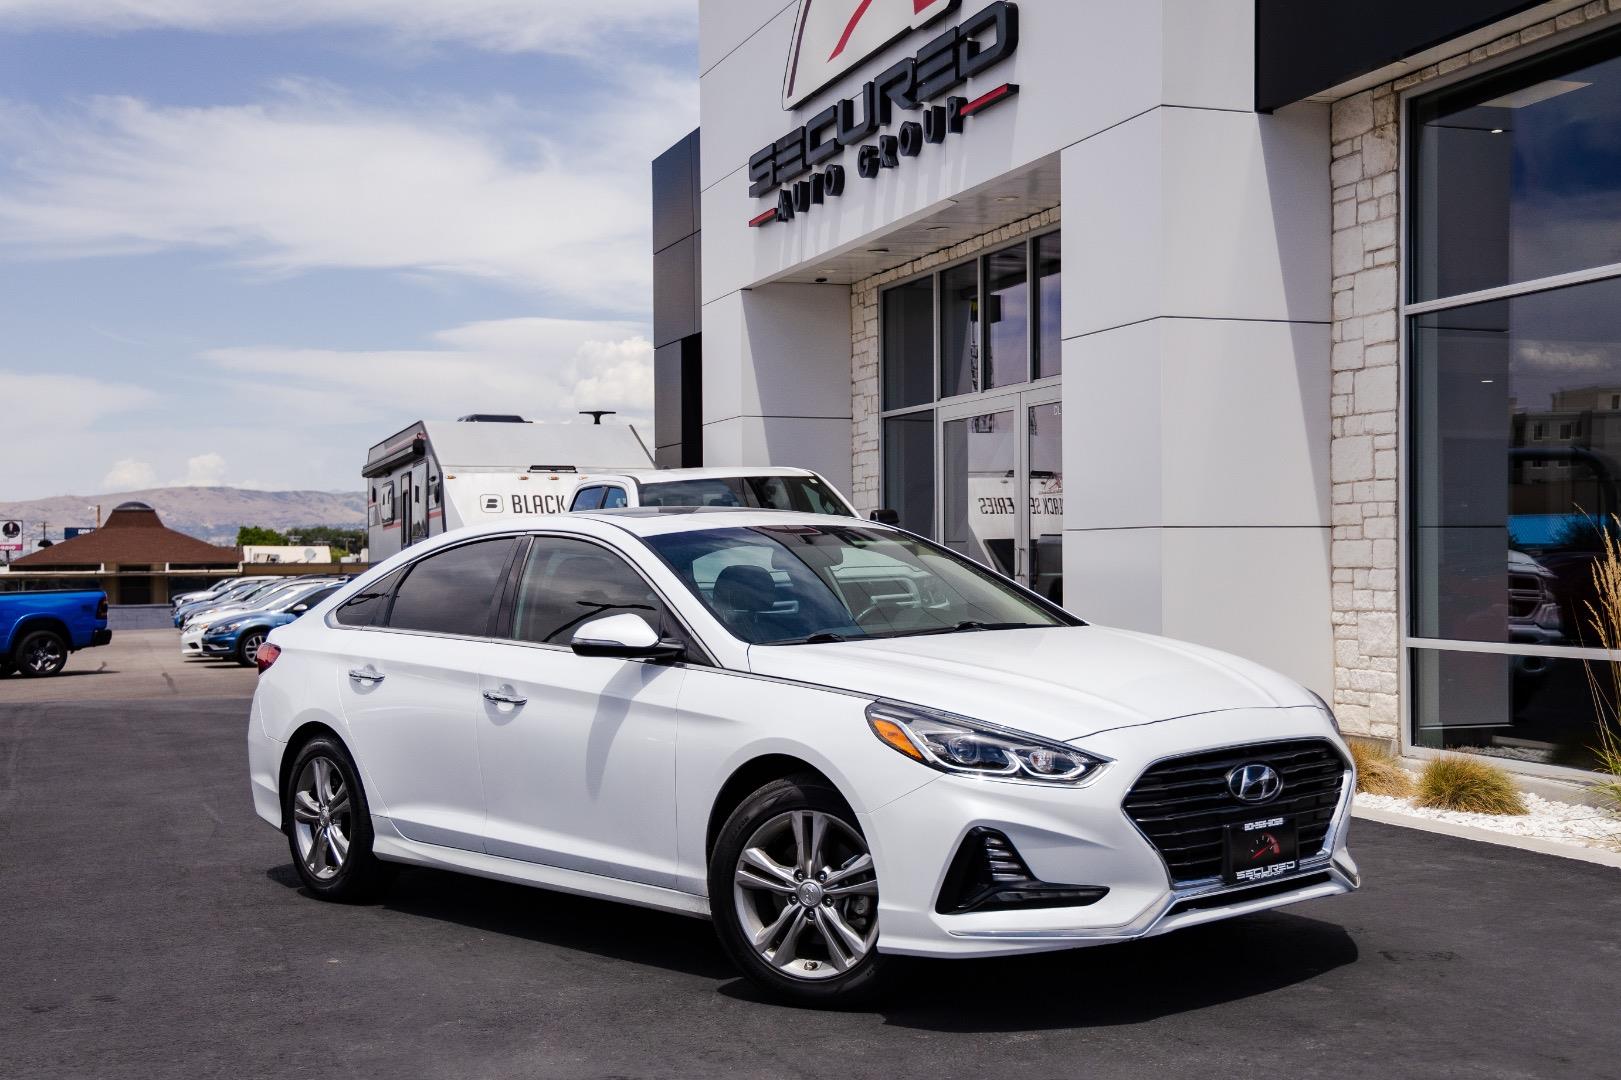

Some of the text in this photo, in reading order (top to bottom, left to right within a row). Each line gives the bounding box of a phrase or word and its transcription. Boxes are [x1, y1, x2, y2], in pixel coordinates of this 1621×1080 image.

[749, 1, 1019, 198] SECURED
[776, 96, 968, 222] AUTO GROUP
[511, 494, 566, 514] BLACK
[1236, 861, 1296, 880] SECURED
